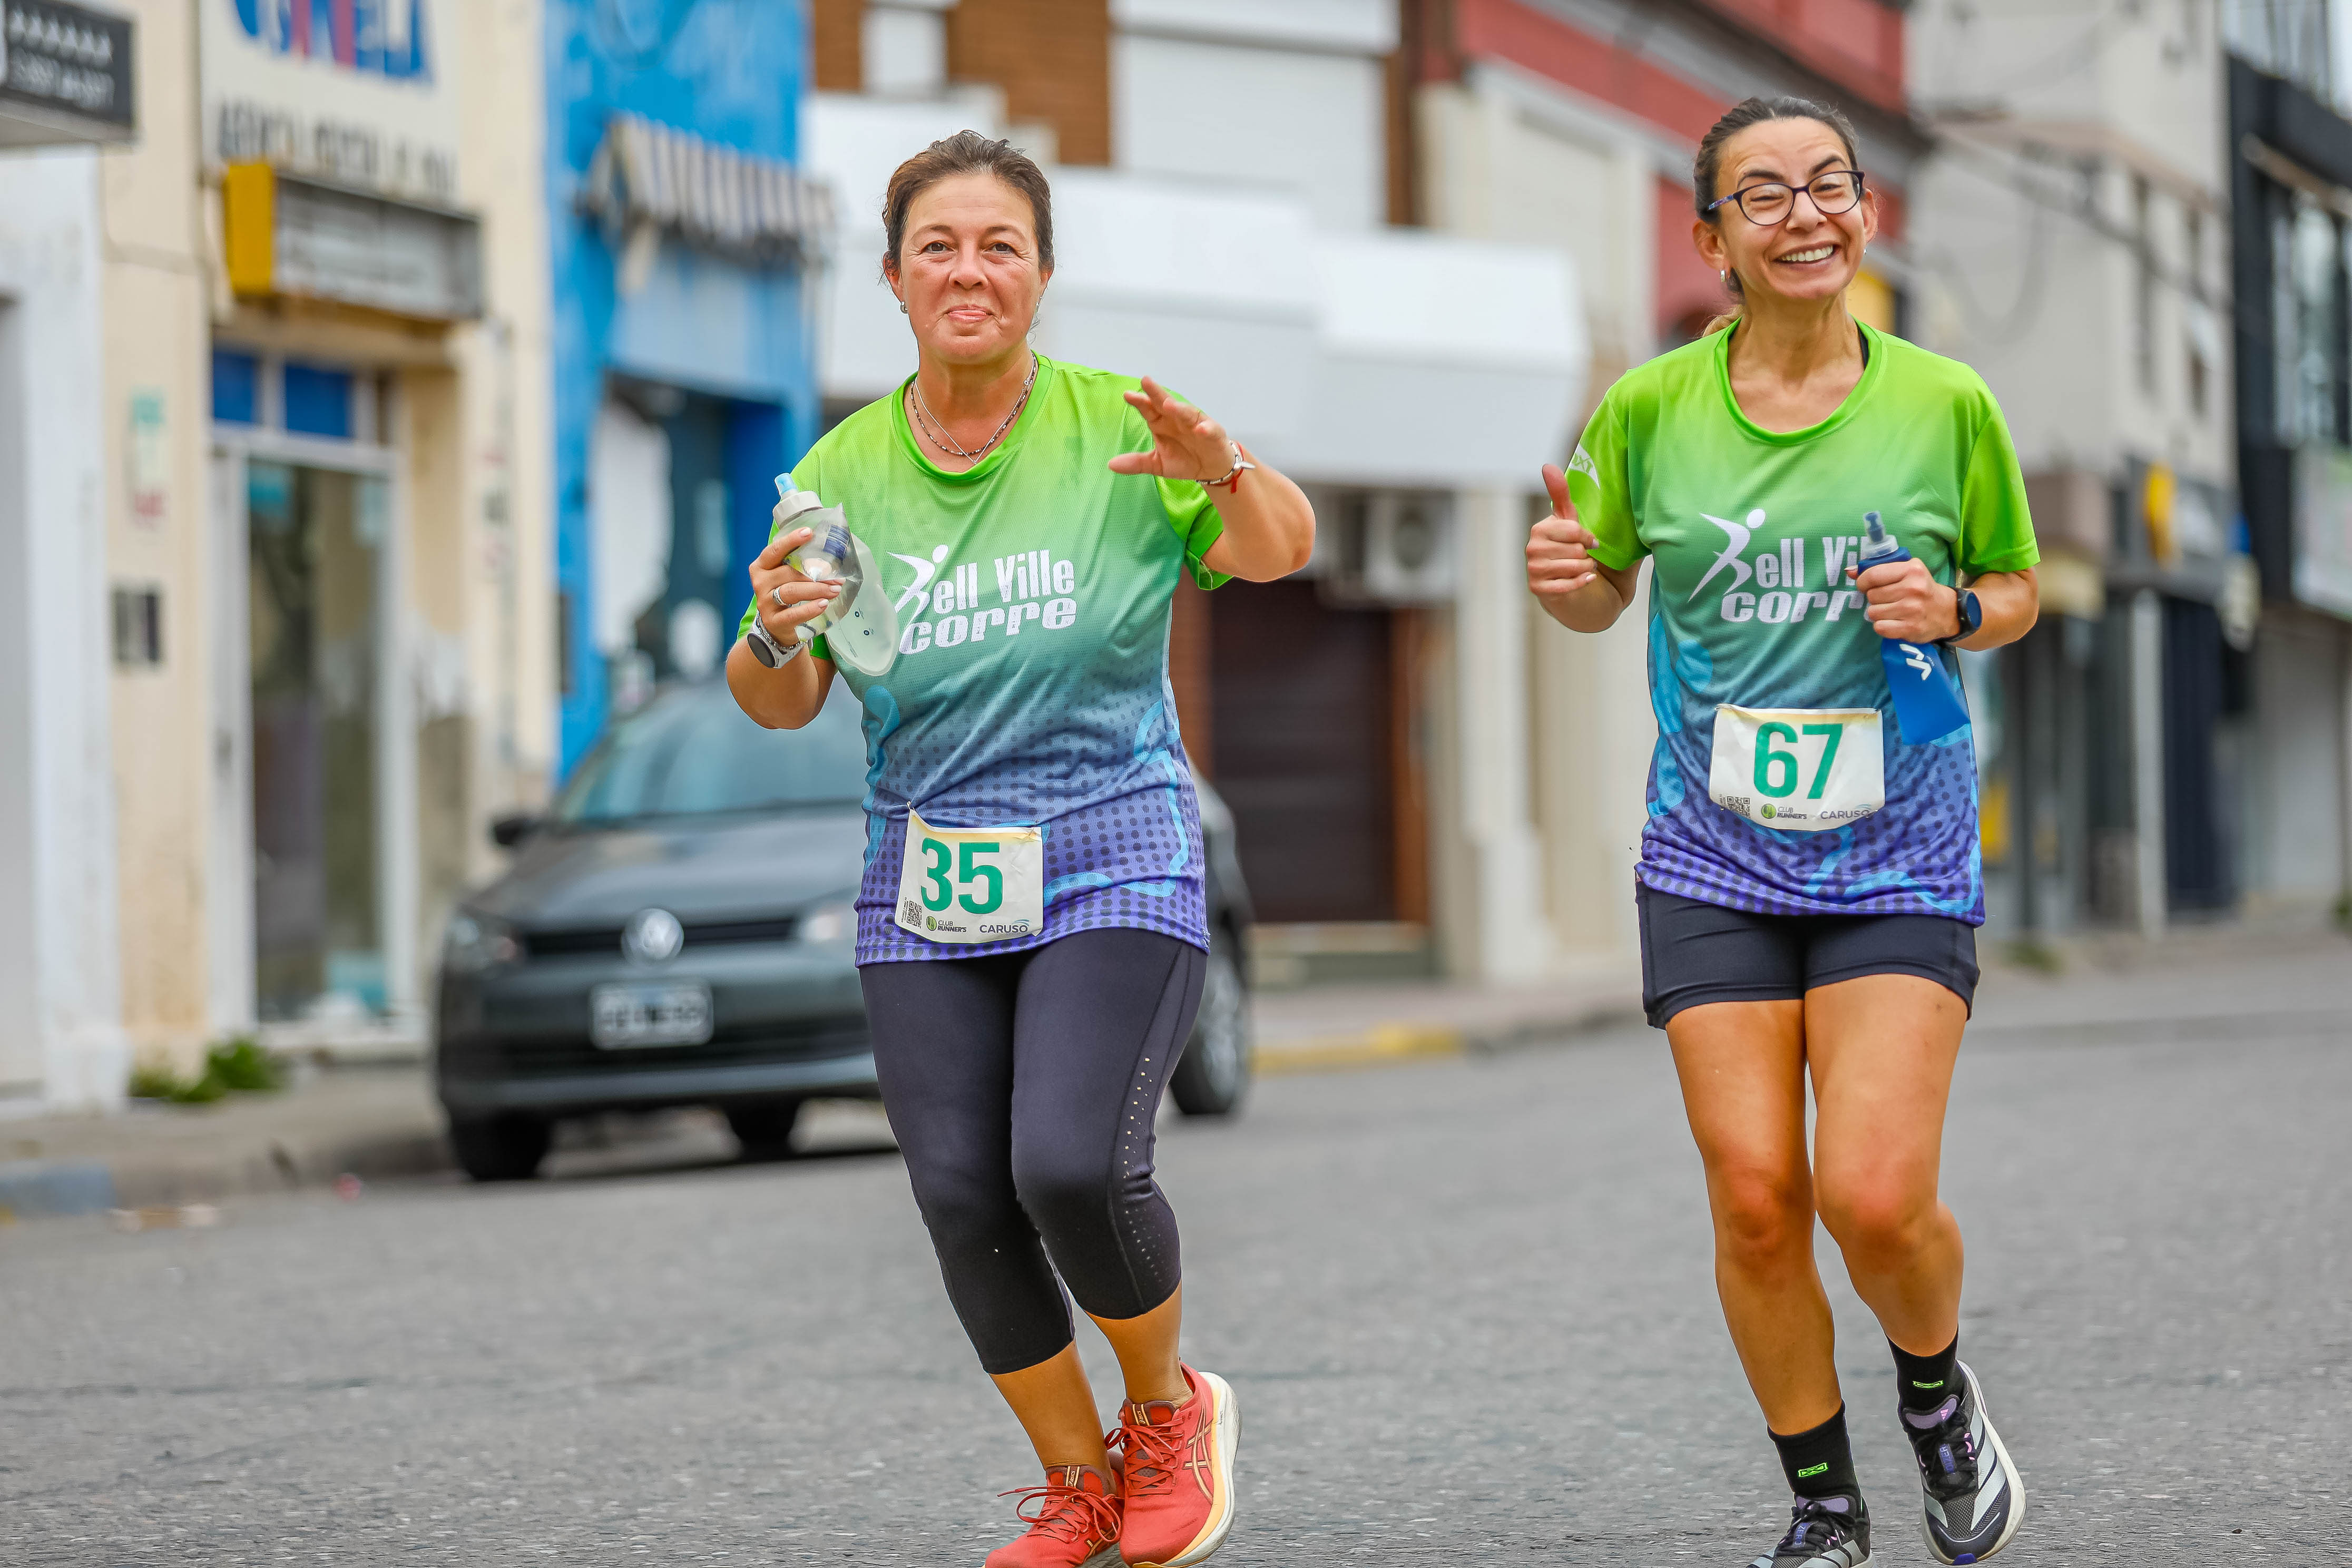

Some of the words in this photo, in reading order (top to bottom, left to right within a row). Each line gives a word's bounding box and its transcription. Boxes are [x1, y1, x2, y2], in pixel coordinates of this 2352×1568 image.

[994, 550, 1075, 603] Ville
[899, 597, 1077, 654] corre
[1721, 590, 1874, 623] corr
[1753, 721, 1844, 799] 67
[1820, 809, 1870, 819] CARUSO
[920, 837, 1003, 915] 35
[979, 925, 1028, 933] CARUSO
